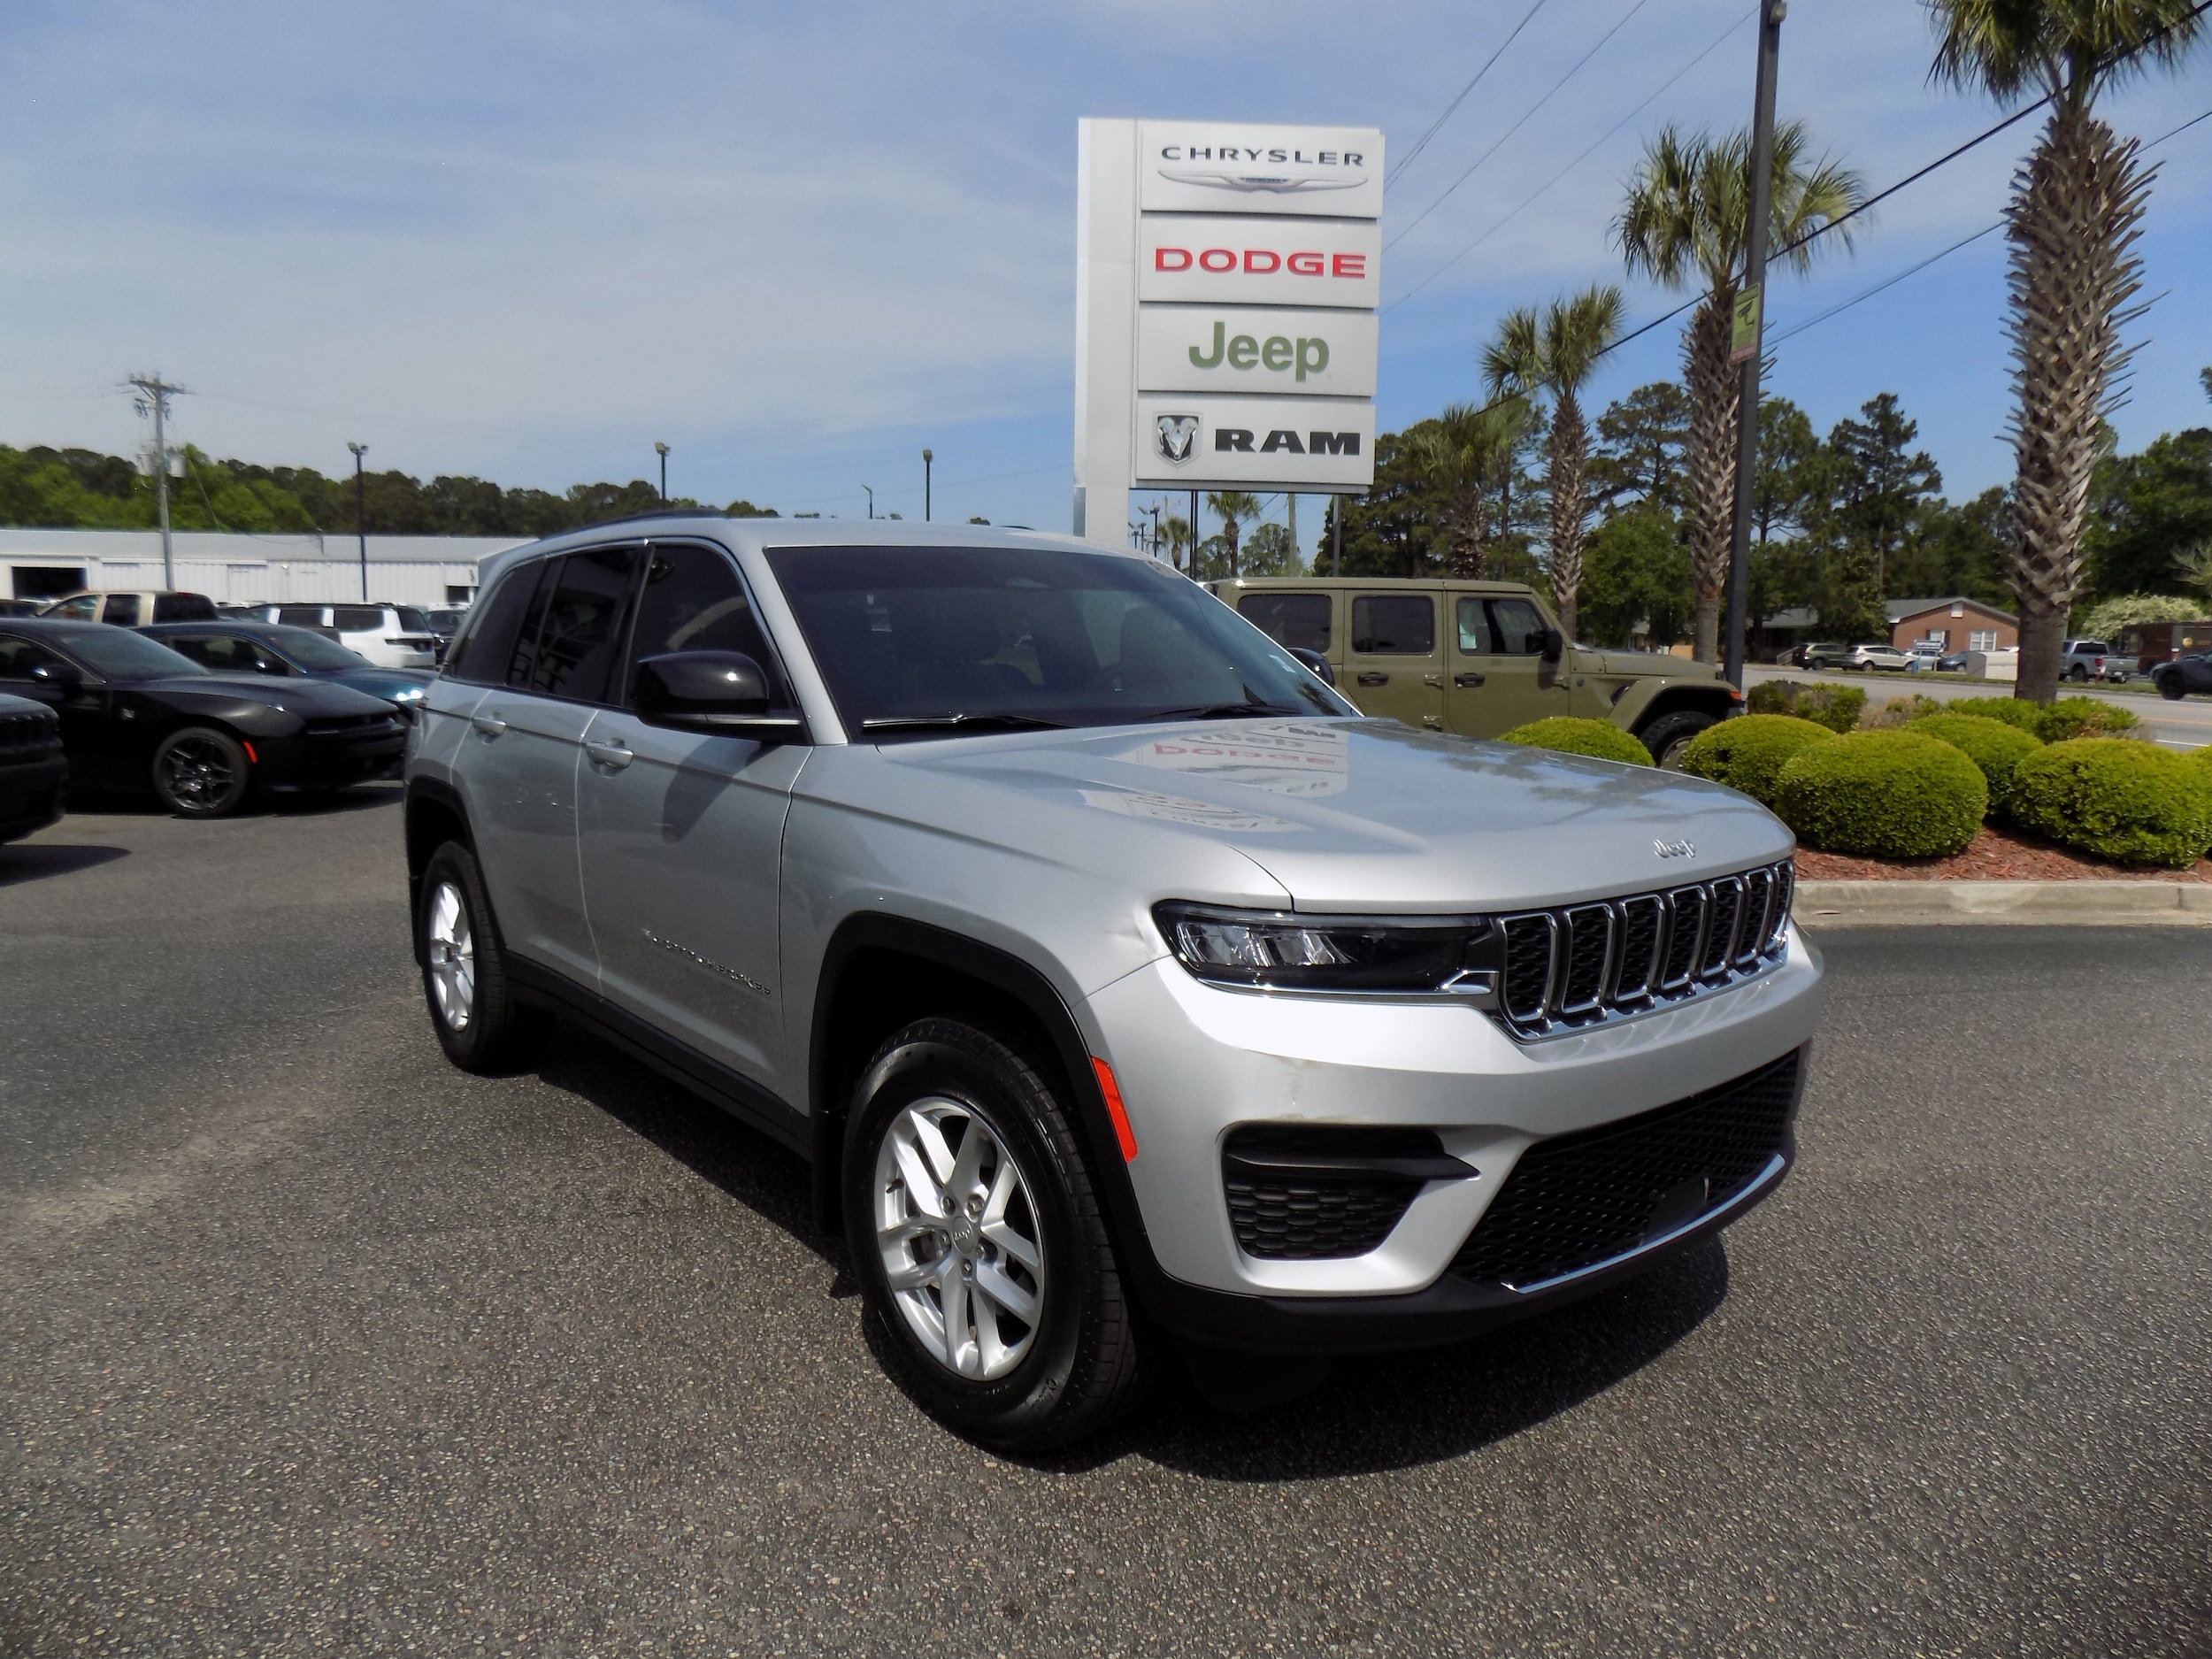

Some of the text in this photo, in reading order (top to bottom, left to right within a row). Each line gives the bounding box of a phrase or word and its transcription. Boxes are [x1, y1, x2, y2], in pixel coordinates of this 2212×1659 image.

[1161, 146, 1364, 167] CHRYSLER
[1155, 248, 1367, 280] DODGE
[1188, 320, 1330, 382] Jeep
[1215, 428, 1362, 457] RAM
[1653, 839, 1696, 859] Jeep
